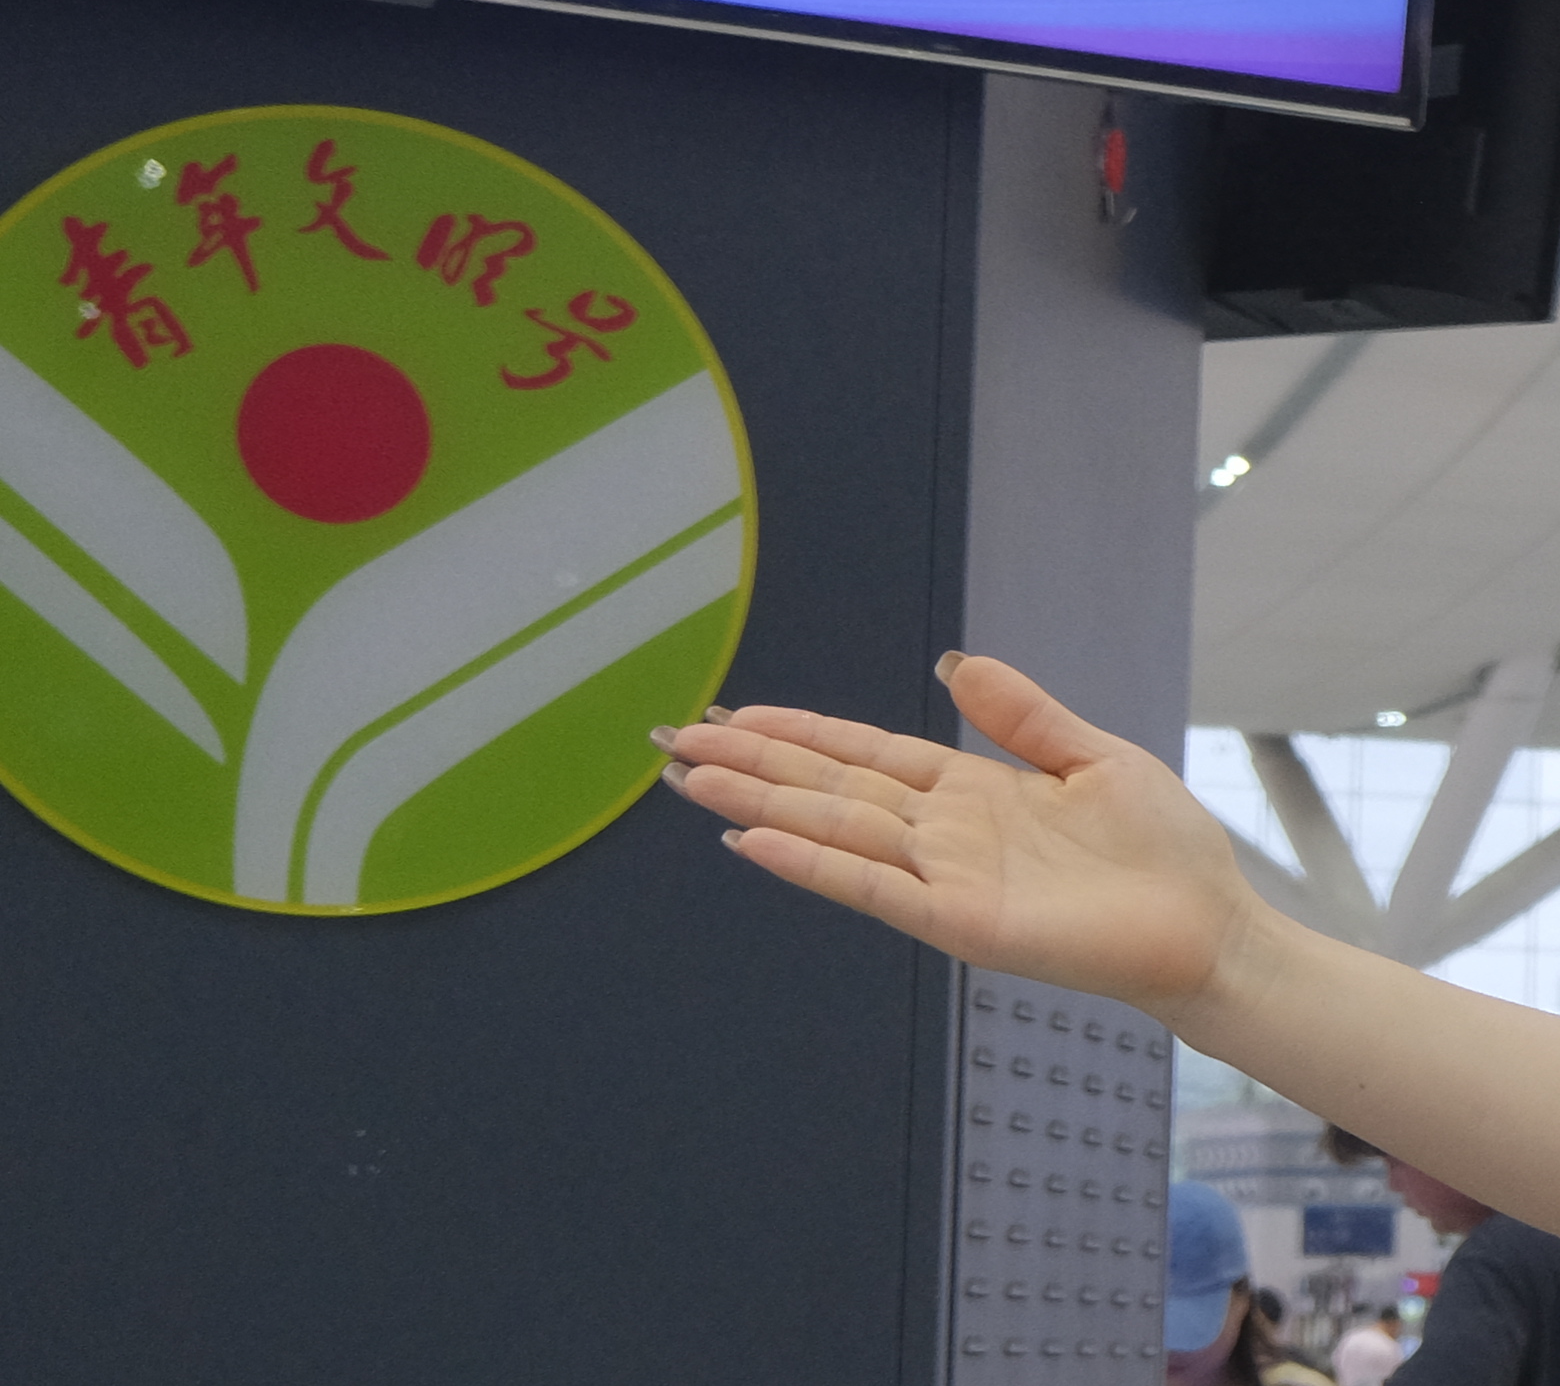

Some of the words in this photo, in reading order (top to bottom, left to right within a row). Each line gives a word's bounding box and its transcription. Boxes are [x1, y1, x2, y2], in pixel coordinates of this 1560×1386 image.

[59, 137, 640, 392] 青年文明号
